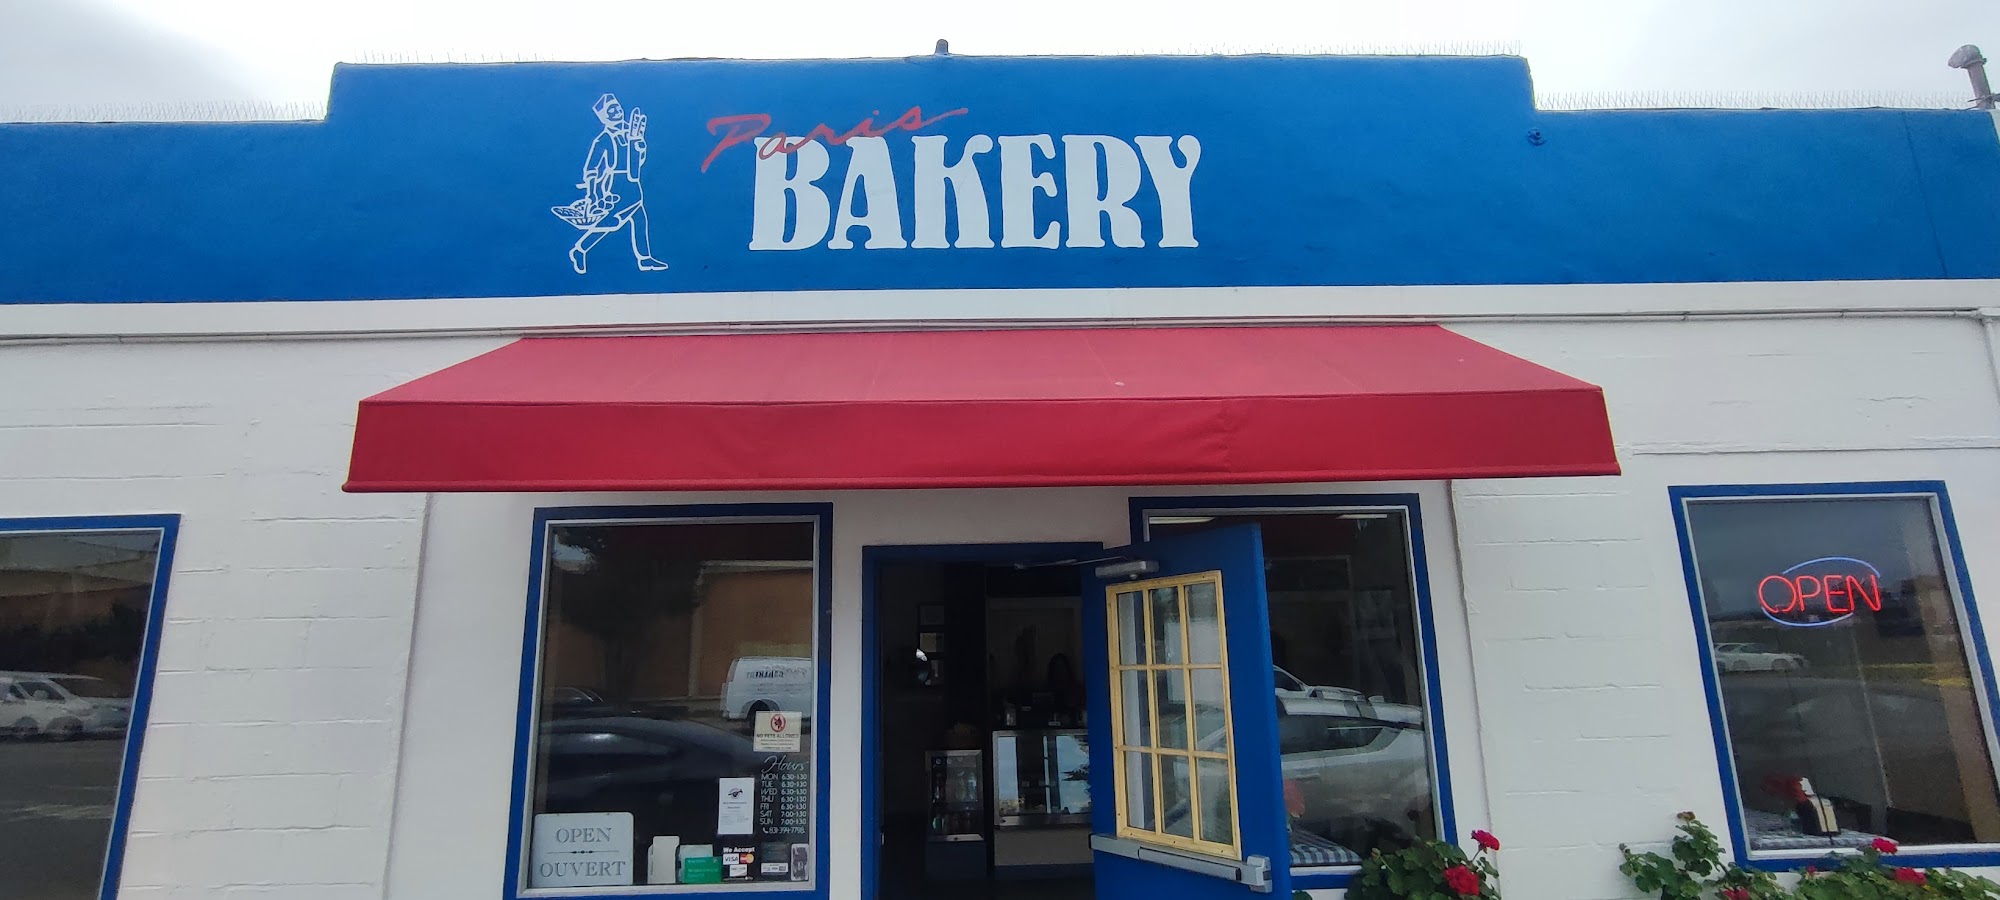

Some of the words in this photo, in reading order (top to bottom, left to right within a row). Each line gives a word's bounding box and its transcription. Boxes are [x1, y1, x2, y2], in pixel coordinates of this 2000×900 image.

[701, 105, 968, 174] Paris
[748, 133, 1201, 251] BAKERY
[1758, 575, 1882, 613] OPEN
[761, 755, 807, 774] Hours
[556, 827, 612, 843] OPEN
[540, 861, 626, 877] OUVERT
